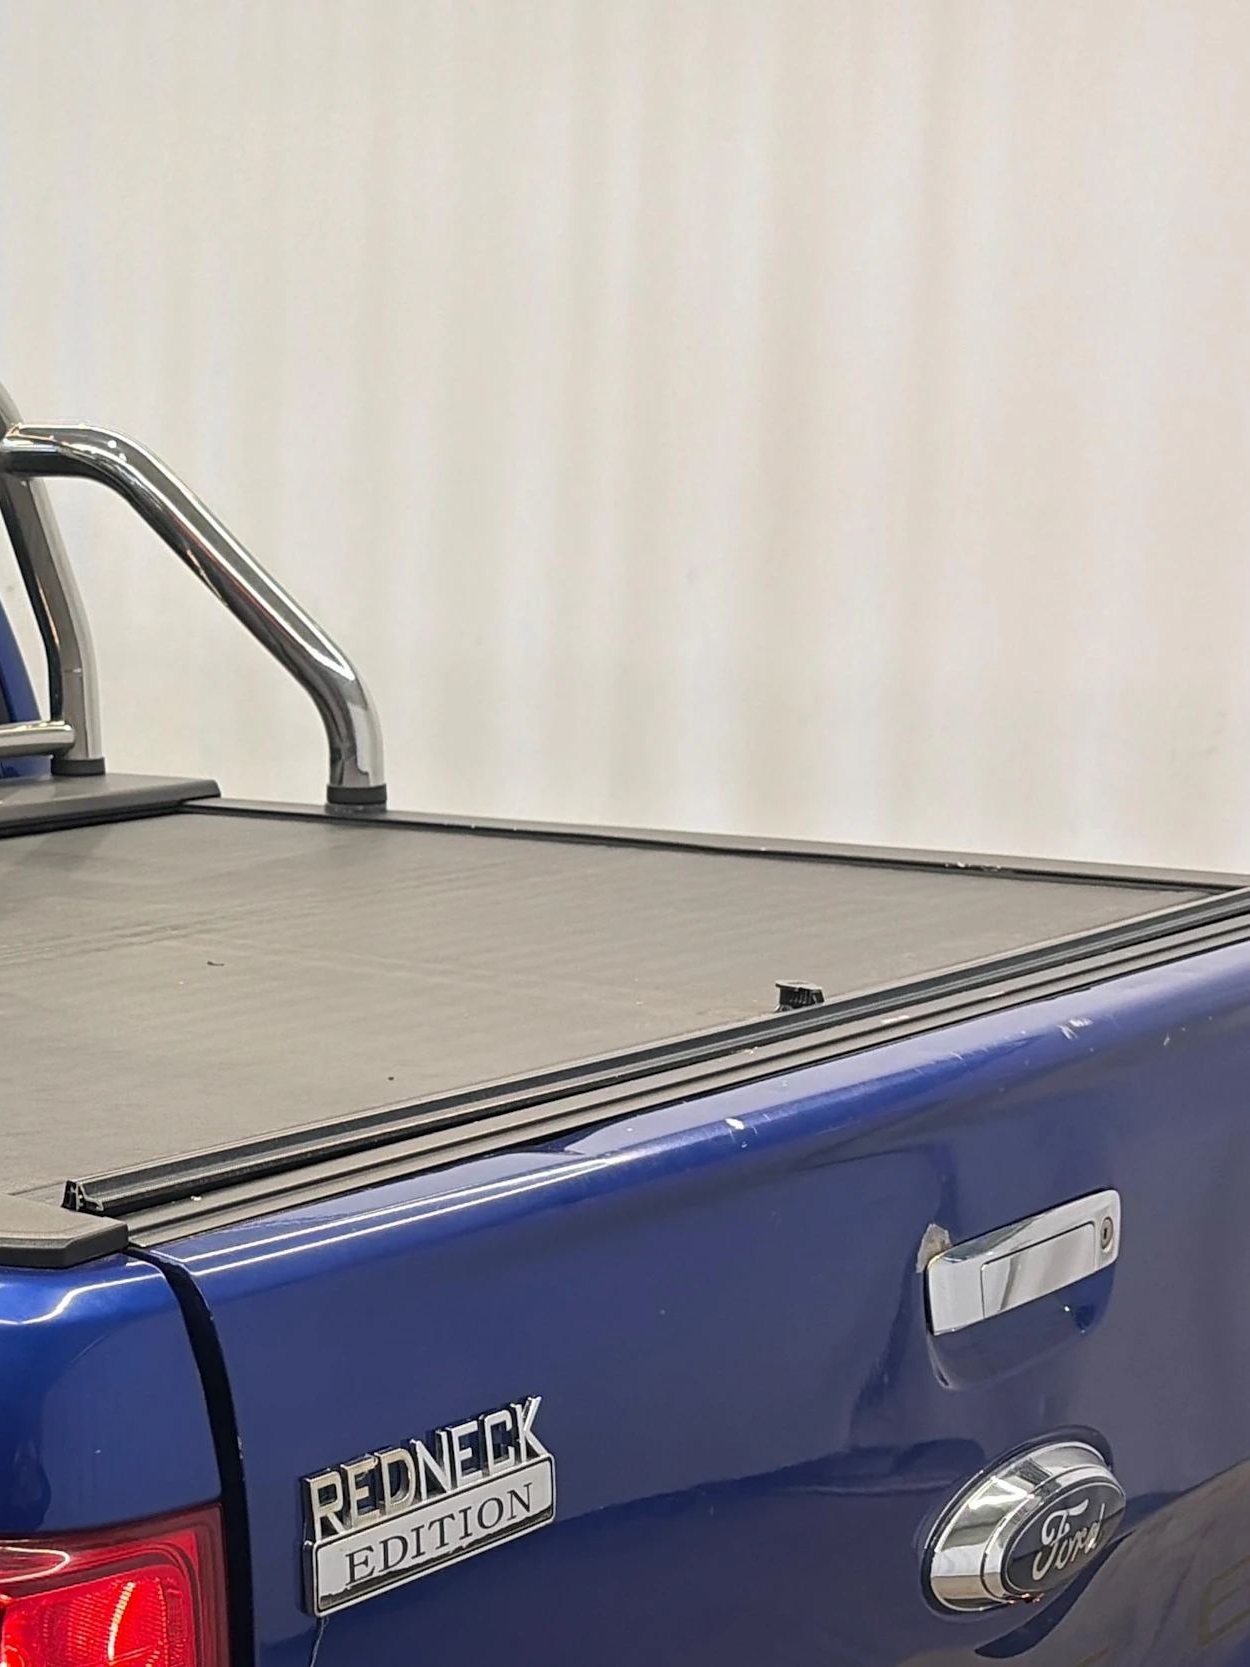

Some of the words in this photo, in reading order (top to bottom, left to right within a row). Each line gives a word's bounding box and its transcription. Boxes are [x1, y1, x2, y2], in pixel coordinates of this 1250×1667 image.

[306, 1395, 548, 1543] REDNECK
[344, 1481, 534, 1586] EDITION
[1031, 1498, 1106, 1582] Ford
